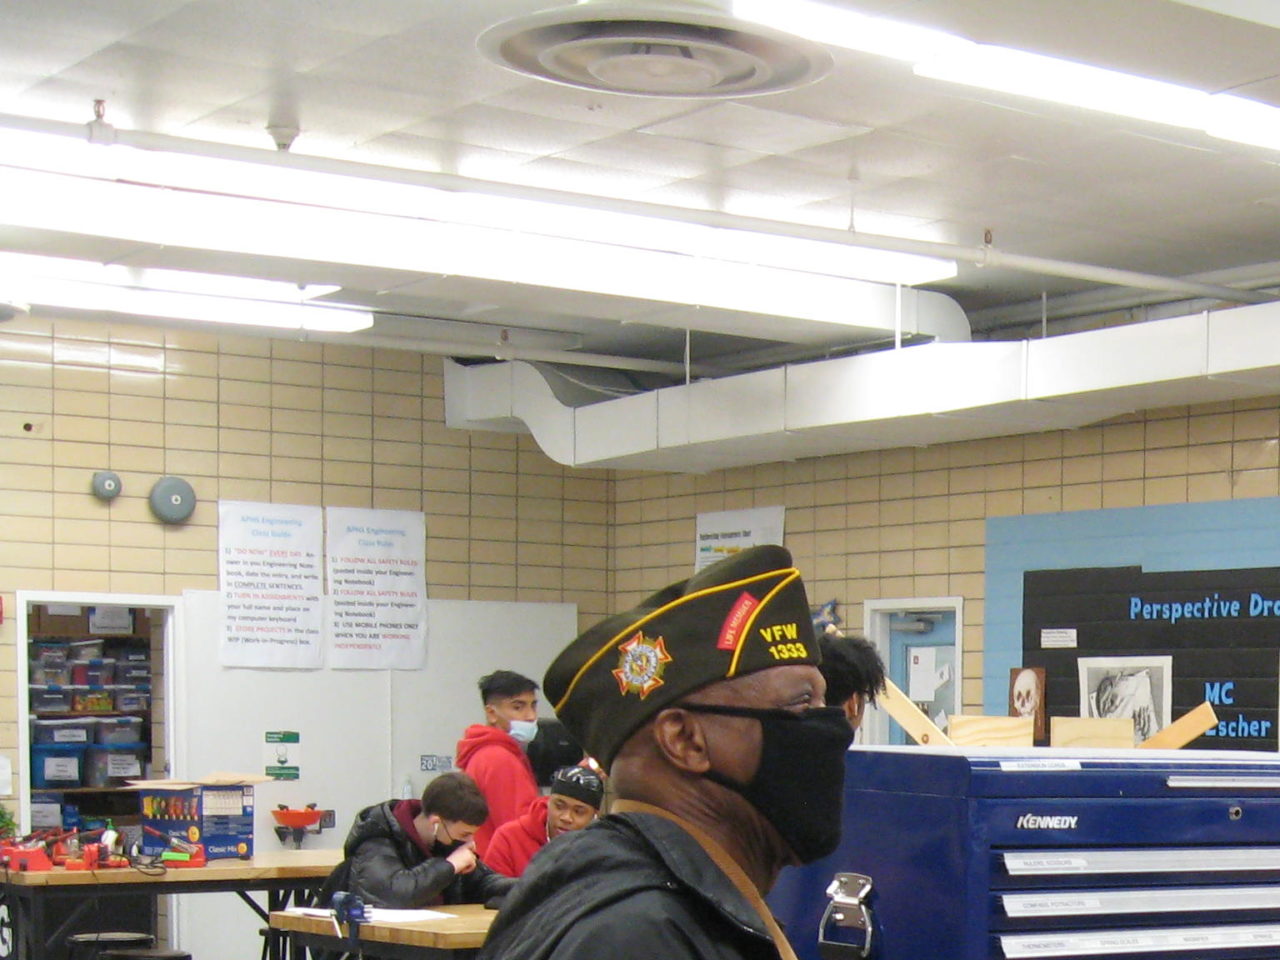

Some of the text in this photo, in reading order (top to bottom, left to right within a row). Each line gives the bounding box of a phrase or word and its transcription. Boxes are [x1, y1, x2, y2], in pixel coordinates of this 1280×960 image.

[263, 561, 297, 569] Engineering
[378, 590, 398, 598] SAFETY
[730, 599, 753, 628] MEMBER
[1130, 593, 1240, 624] Perspective
[759, 623, 798, 643] VFW
[769, 643, 807, 660] 1333
[1205, 682, 1234, 705] MC
[1017, 813, 1078, 829] KENNEDY
